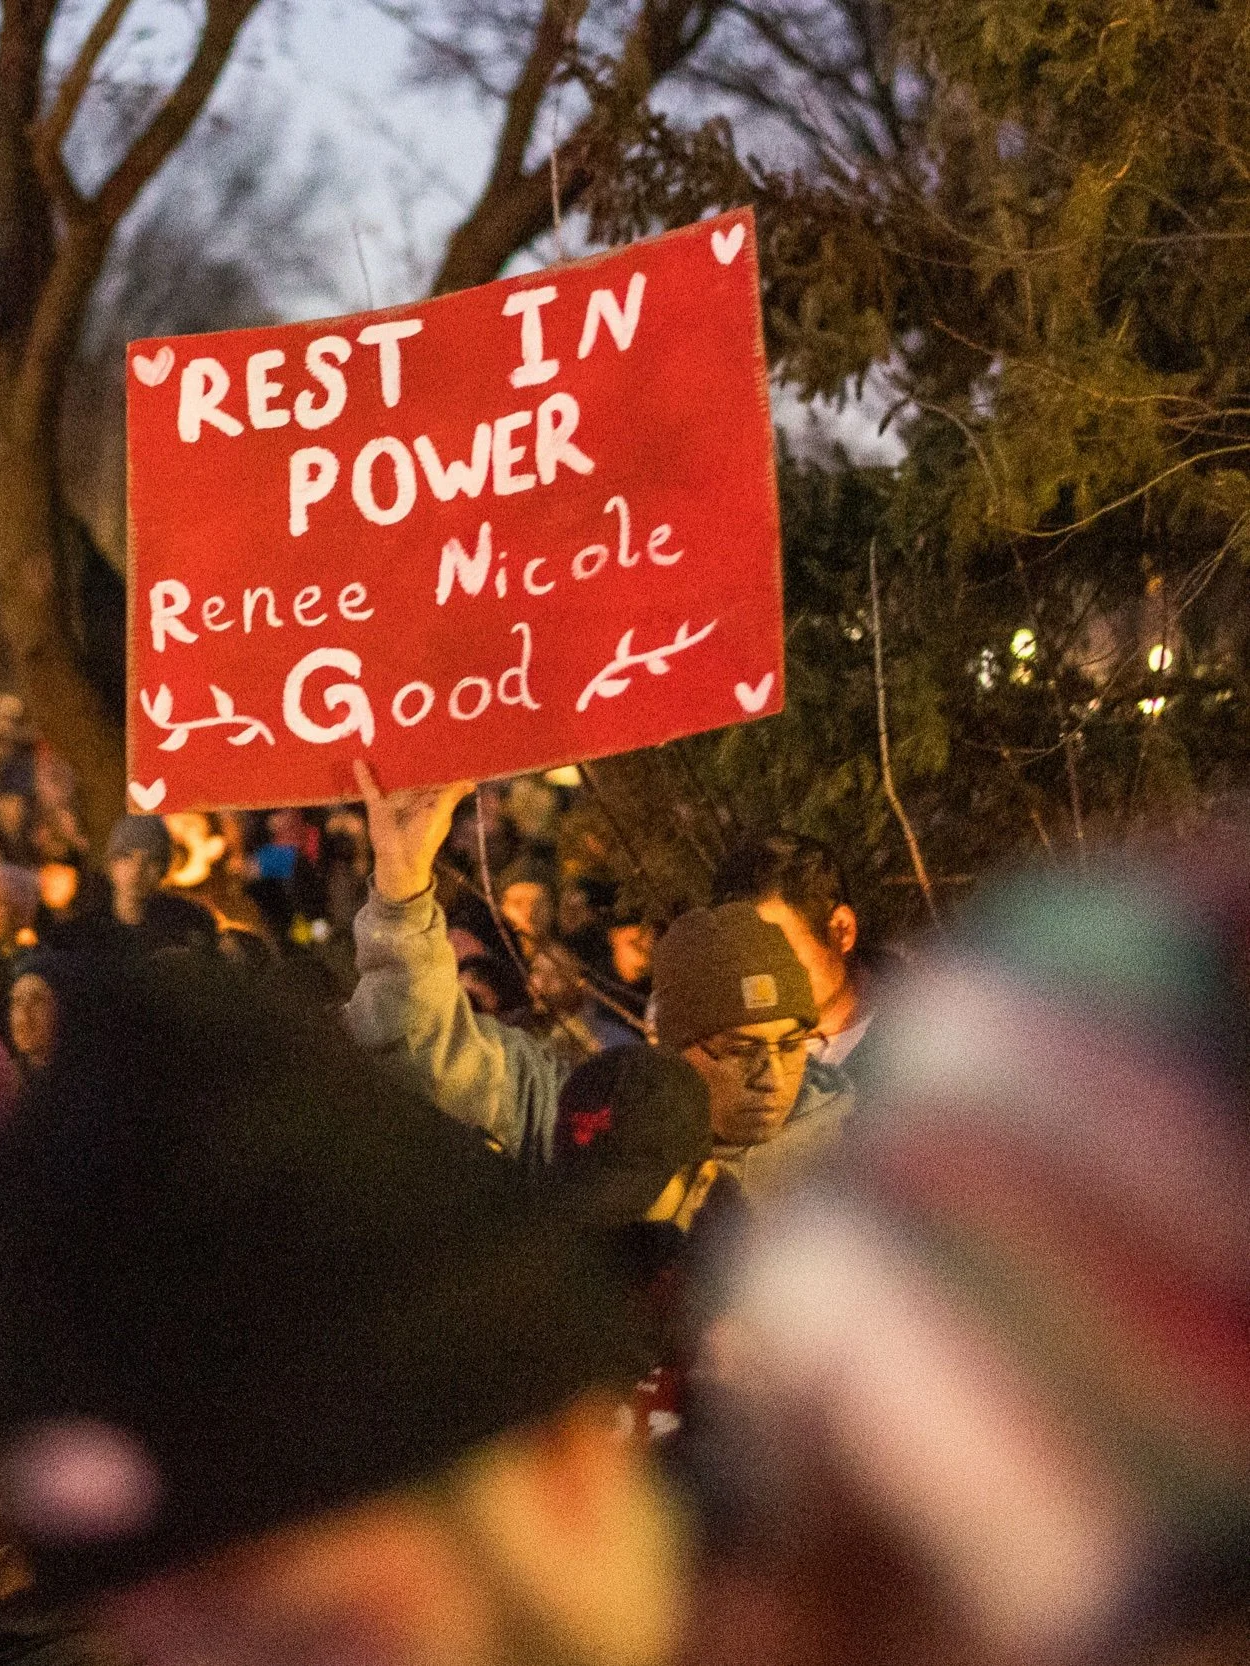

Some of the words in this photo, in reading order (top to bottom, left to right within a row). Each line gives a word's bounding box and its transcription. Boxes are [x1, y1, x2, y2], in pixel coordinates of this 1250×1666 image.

[176, 319, 423, 443] REST
[502, 272, 647, 389] IN
[289, 392, 595, 537] POWER
[150, 579, 375, 652] Renee
[435, 495, 684, 606] Nicole
[282, 622, 540, 747] Good
